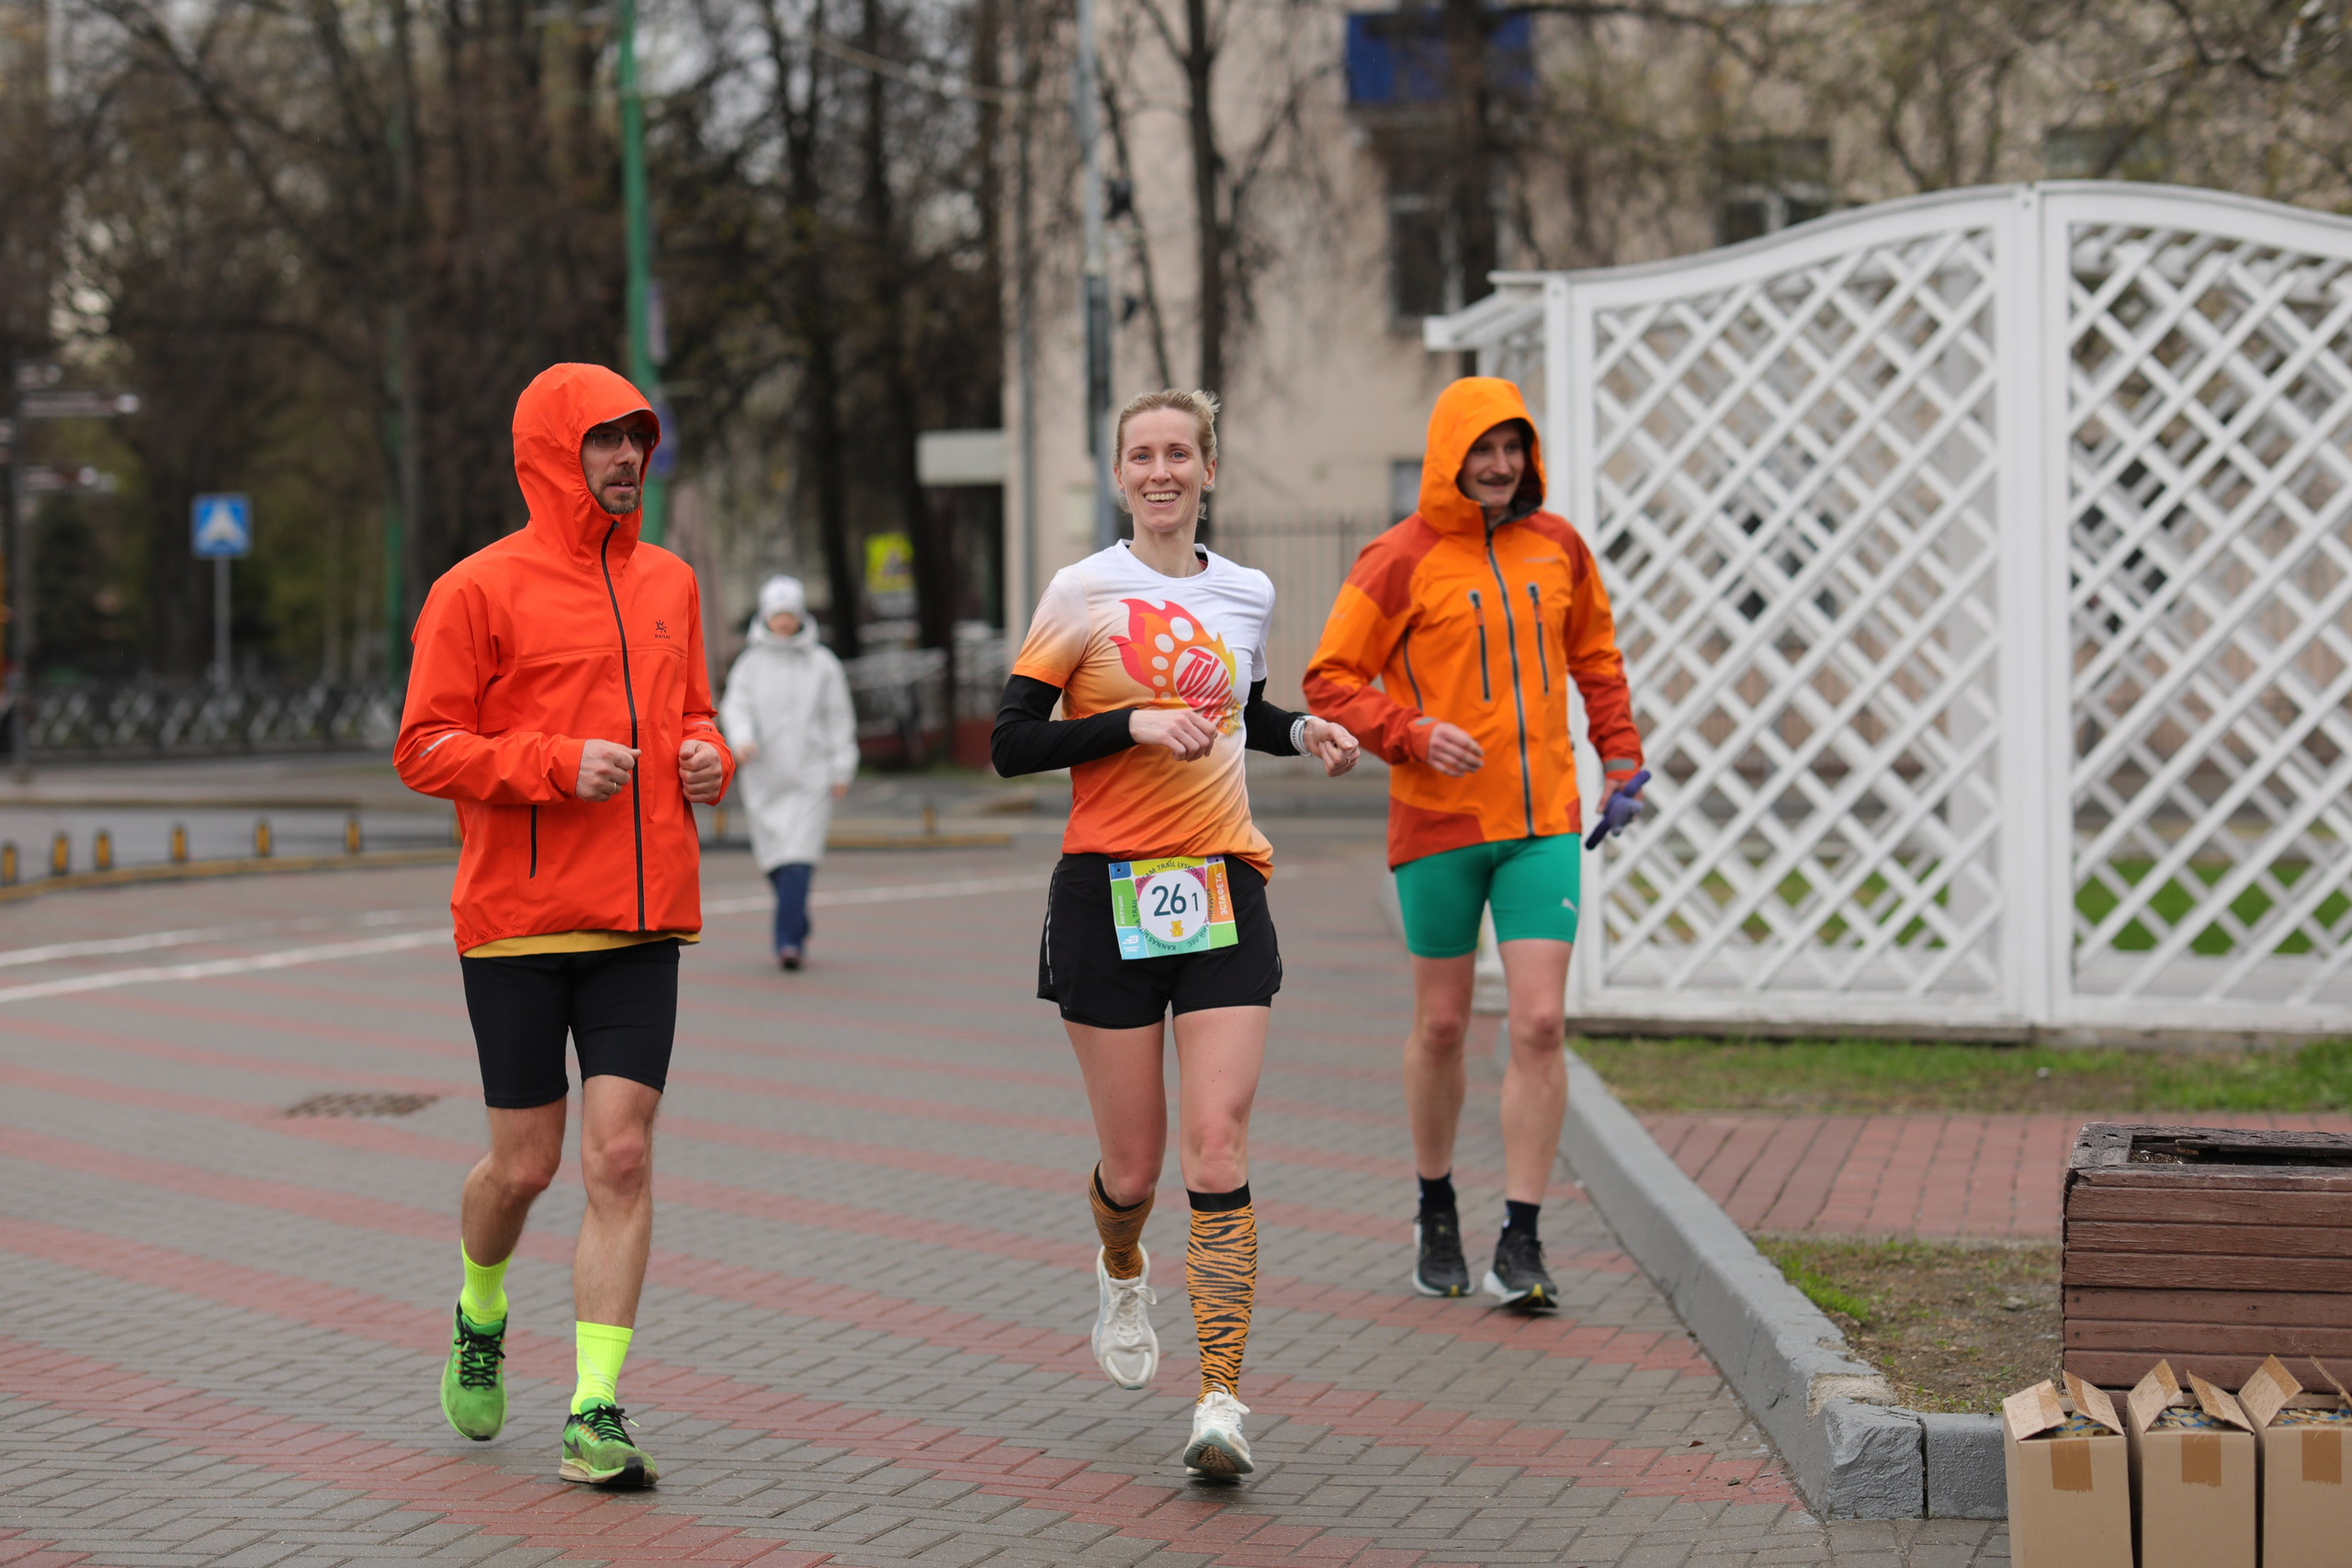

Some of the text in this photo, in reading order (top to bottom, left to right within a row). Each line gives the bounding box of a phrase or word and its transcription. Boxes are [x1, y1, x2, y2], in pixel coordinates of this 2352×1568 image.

[1136, 862, 1203, 889] DREAM TRAIL LYSKOVO
[1151, 883, 1187, 917] 26
[1216, 872, 1228, 916] ЭСТАФЕТА
[1148, 937, 1176, 951] KANNAS
[1187, 935, 1199, 947] ЛЕС
